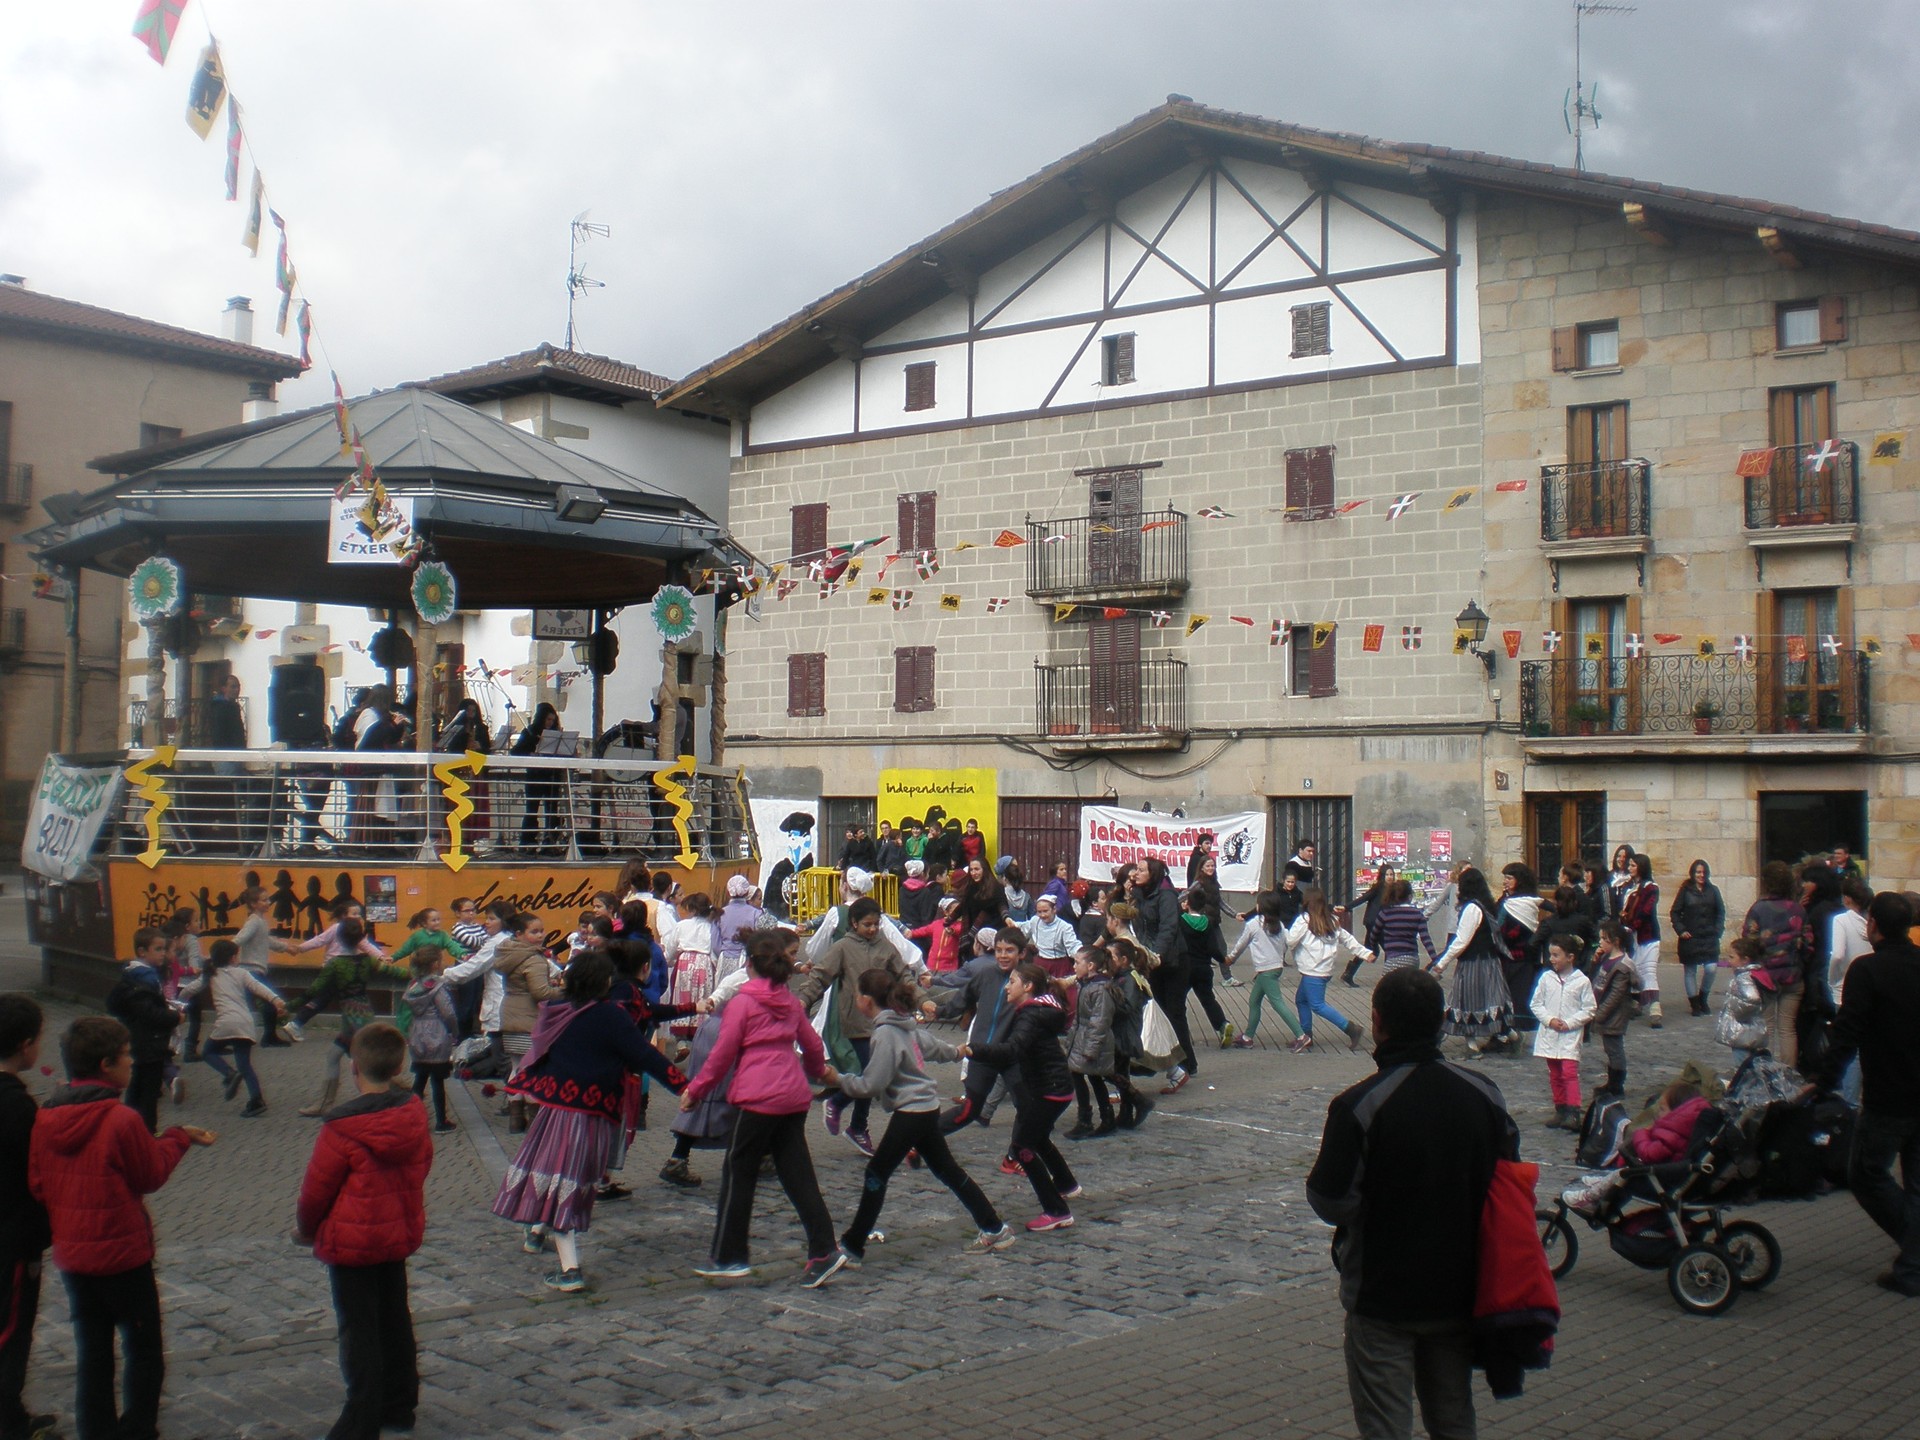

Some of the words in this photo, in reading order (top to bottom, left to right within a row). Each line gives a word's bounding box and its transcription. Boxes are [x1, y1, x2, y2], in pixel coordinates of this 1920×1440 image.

[339, 541, 389, 554] ETXER
[1497, 774, 1507, 786] 9
[886, 782, 975, 797] independentzia
[1091, 843, 1220, 867] HERRIARENTT
